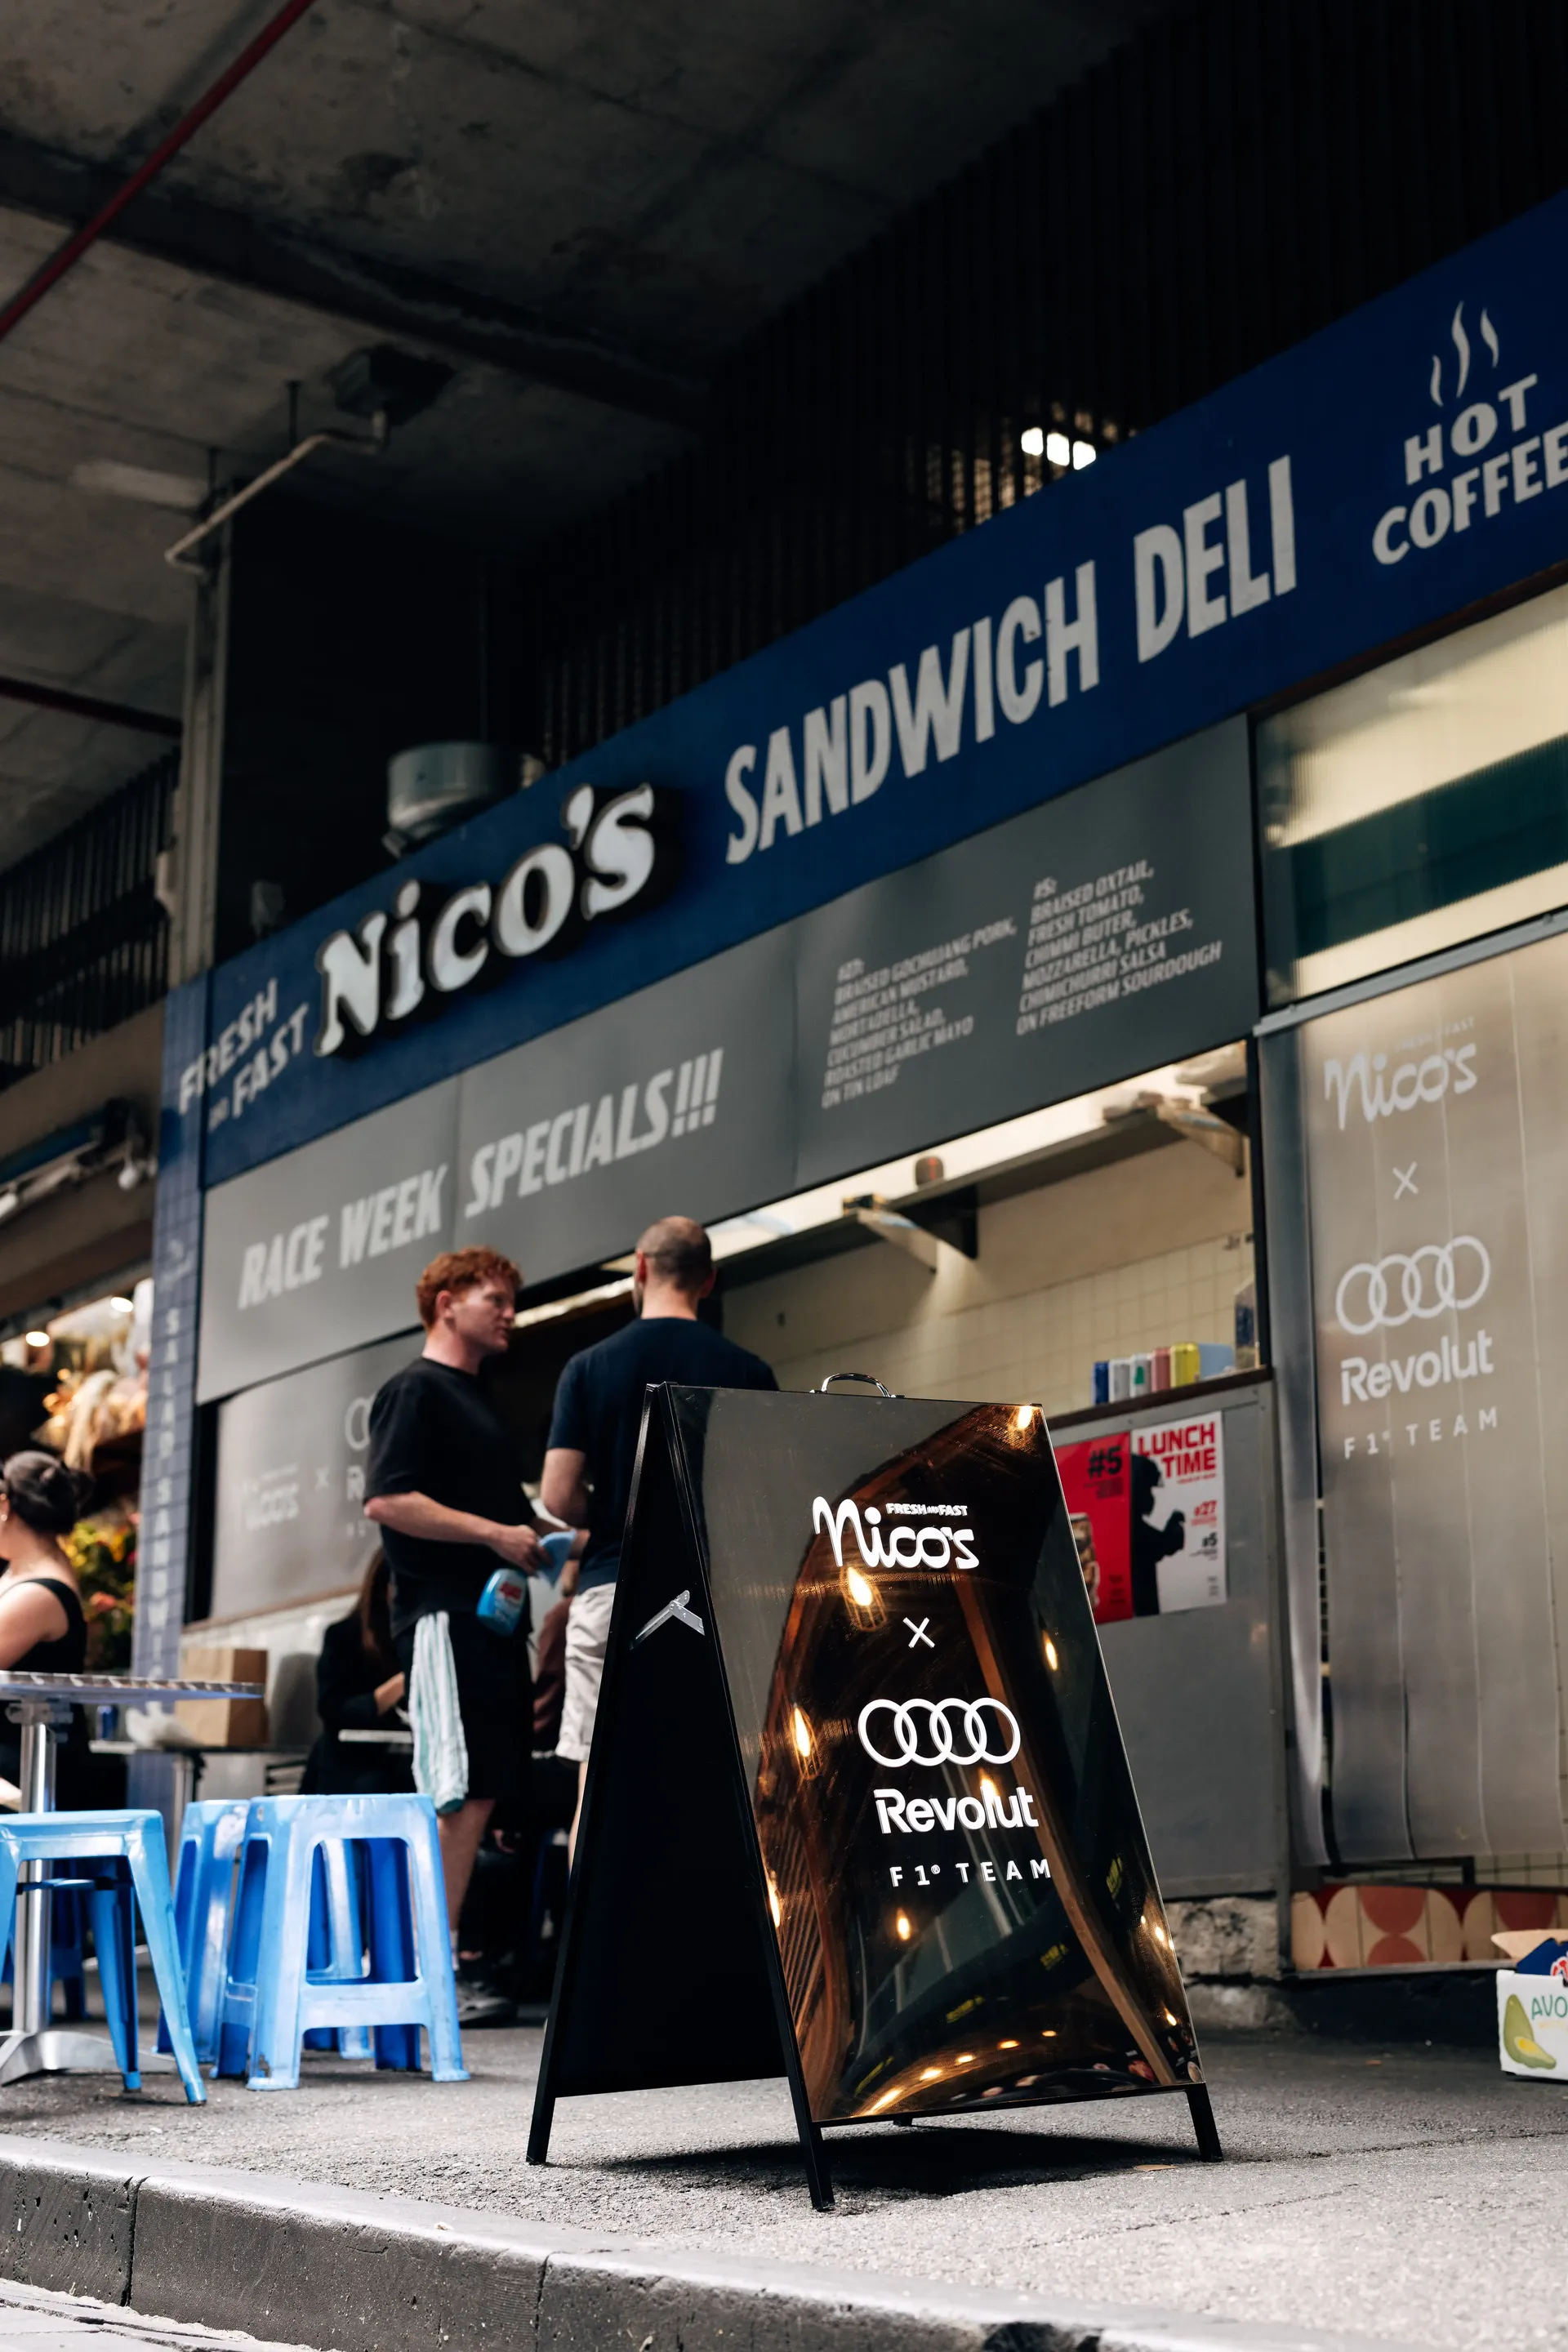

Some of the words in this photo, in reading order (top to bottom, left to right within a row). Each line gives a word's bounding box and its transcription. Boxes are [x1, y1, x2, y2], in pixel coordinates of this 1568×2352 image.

[1404, 372, 1538, 486] HOT
[1372, 421, 1568, 565] COFFEE
[724, 559, 1099, 864] SANDWICH
[1134, 455, 1297, 663] DELI
[1028, 911, 1076, 947] FRESH
[1078, 884, 1145, 926] TOMATO,
[1031, 882, 1094, 924] BRAISED
[1096, 859, 1154, 897] OXTAIL,
[1023, 938, 1121, 990] MOZZARELLA,
[1125, 908, 1194, 950] PICKLES,
[1119, 941, 1166, 974] SALSA
[1017, 1013, 1037, 1036] ON
[1040, 979, 1120, 1027] FREEFORM
[1121, 939, 1223, 996] SOURDOUGH
[179, 977, 278, 1116] FRESH
[232, 1001, 310, 1120] FAST
[934, 1015, 973, 1046] MAYO
[822, 1089, 841, 1109] ON
[238, 1214, 329, 1311] RACE
[339, 1164, 448, 1268] WEEK
[465, 1048, 724, 1218] SPECIALS!!!
[1340, 1328, 1494, 1406] Revolut
[1138, 1421, 1215, 1458] LUNCH
[1405, 1406, 1499, 1446] TEAM
[1087, 1446, 1123, 1479] #5
[1161, 1447, 1217, 1479] TIME
[885, 1503, 928, 1515] FRESH
[938, 1504, 968, 1516] FAST
[873, 1786, 1039, 1834] Revolut
[956, 1859, 1051, 1883] TEAM
